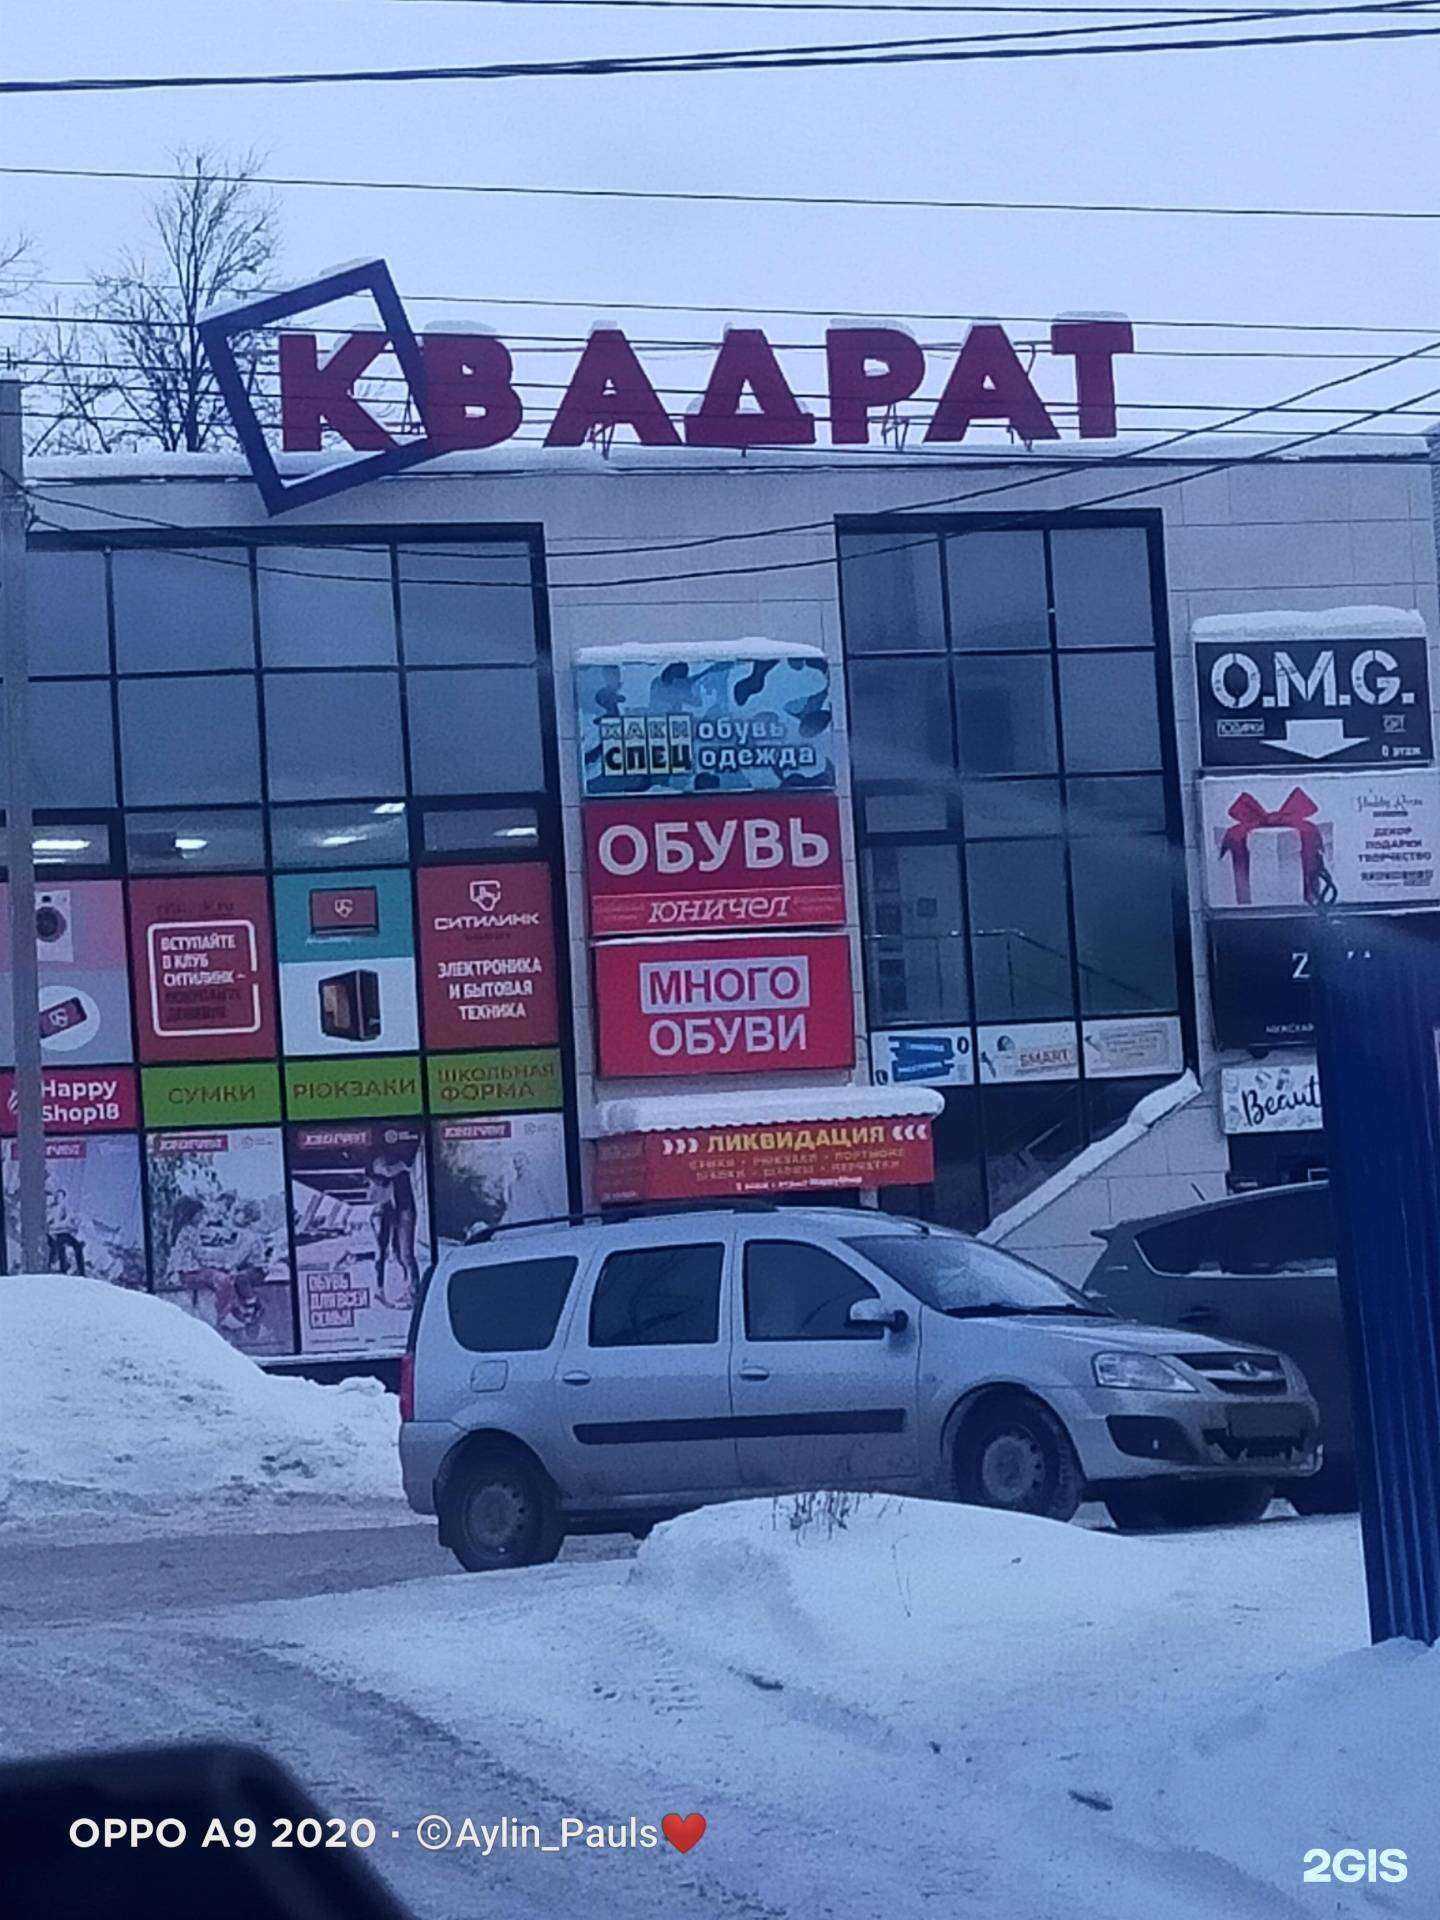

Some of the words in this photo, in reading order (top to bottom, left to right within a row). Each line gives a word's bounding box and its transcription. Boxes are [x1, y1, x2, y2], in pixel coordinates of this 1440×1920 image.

[278, 320, 1135, 452] КВАДРАТ
[1211, 649, 1415, 709] O.M.G.
[699, 716, 785, 744] обувь
[605, 744, 693, 772] СПЕЦ
[702, 746, 815, 770] одежда
[598, 817, 830, 876] ОБУВЬ
[1366, 840, 1422, 850] ПОДАРКИ
[1358, 851, 1432, 862] ТВОРЧЕСТВО
[434, 913, 540, 931] СИТИЛИНК
[160, 933, 236, 951] ВСТУПАЙТЕ
[162, 955, 171, 969] В
[174, 953, 209, 967] КЛУБ
[437, 957, 542, 979] ЭЛЕКТРОНИКА
[164, 970, 234, 986] СИТИЛИНК
[648, 963, 801, 1006] МНОГО
[449, 984, 460, 999] И
[463, 980, 533, 998] БЫТОВАЯ
[458, 1002, 527, 1021] ТЕХНИКА
[648, 1014, 807, 1057] ОБУВИ
[438, 1063, 556, 1084] ШКОЛЬНАЯ
[41, 1078, 118, 1101] Happy
[168, 1085, 256, 1105] СУМКИ
[293, 1079, 417, 1100] РЮКЗАКИ
[440, 1082, 535, 1103] ФОРМА
[42, 1102, 120, 1124] Shop18
[707, 1125, 885, 1153] ЛИКВИДАЦИЯ
